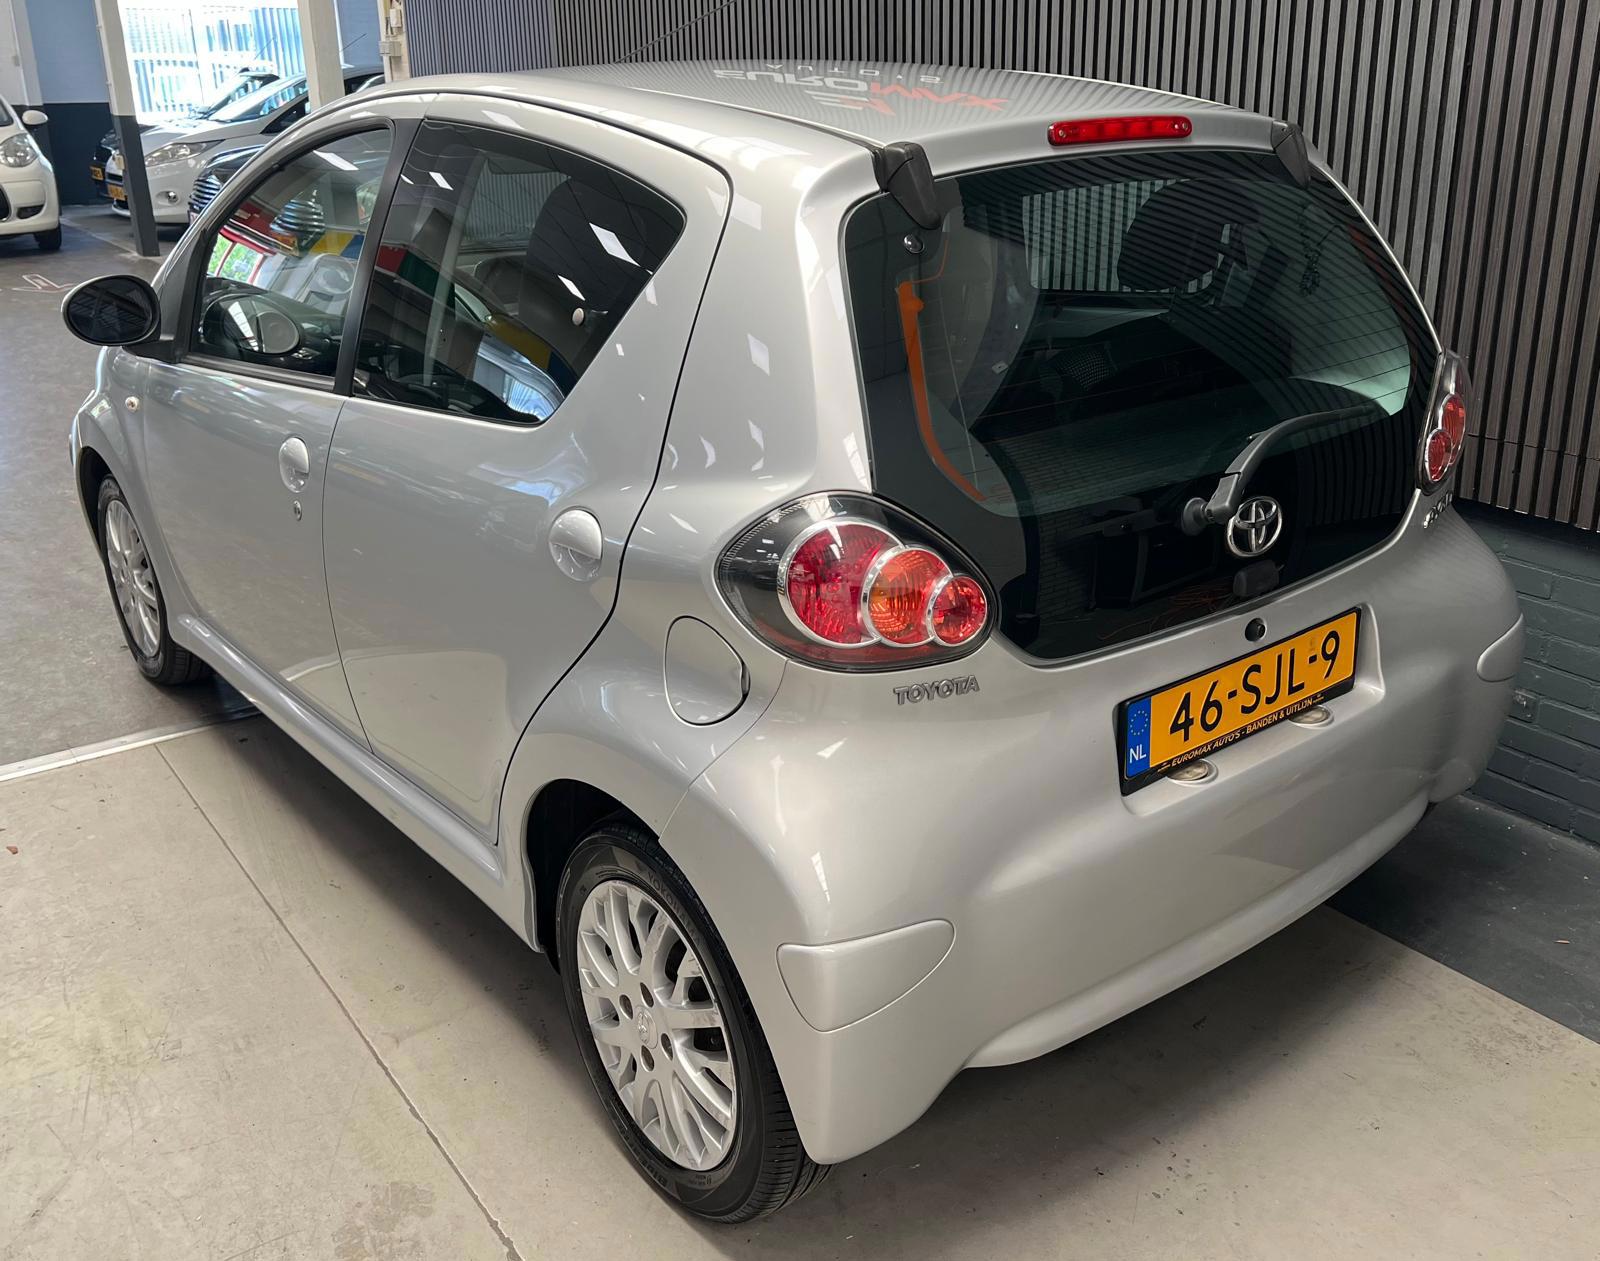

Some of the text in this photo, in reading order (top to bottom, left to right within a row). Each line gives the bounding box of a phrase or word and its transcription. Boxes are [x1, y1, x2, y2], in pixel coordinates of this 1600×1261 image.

[893, 674, 980, 705] TOYOTA
[1168, 630, 1341, 742] 46-SJL-9
[1129, 743, 1147, 765] NL
[1171, 743, 1212, 767] EUROMAX
[1246, 712, 1280, 735] BANDEN
[1279, 710, 1285, 719] &
